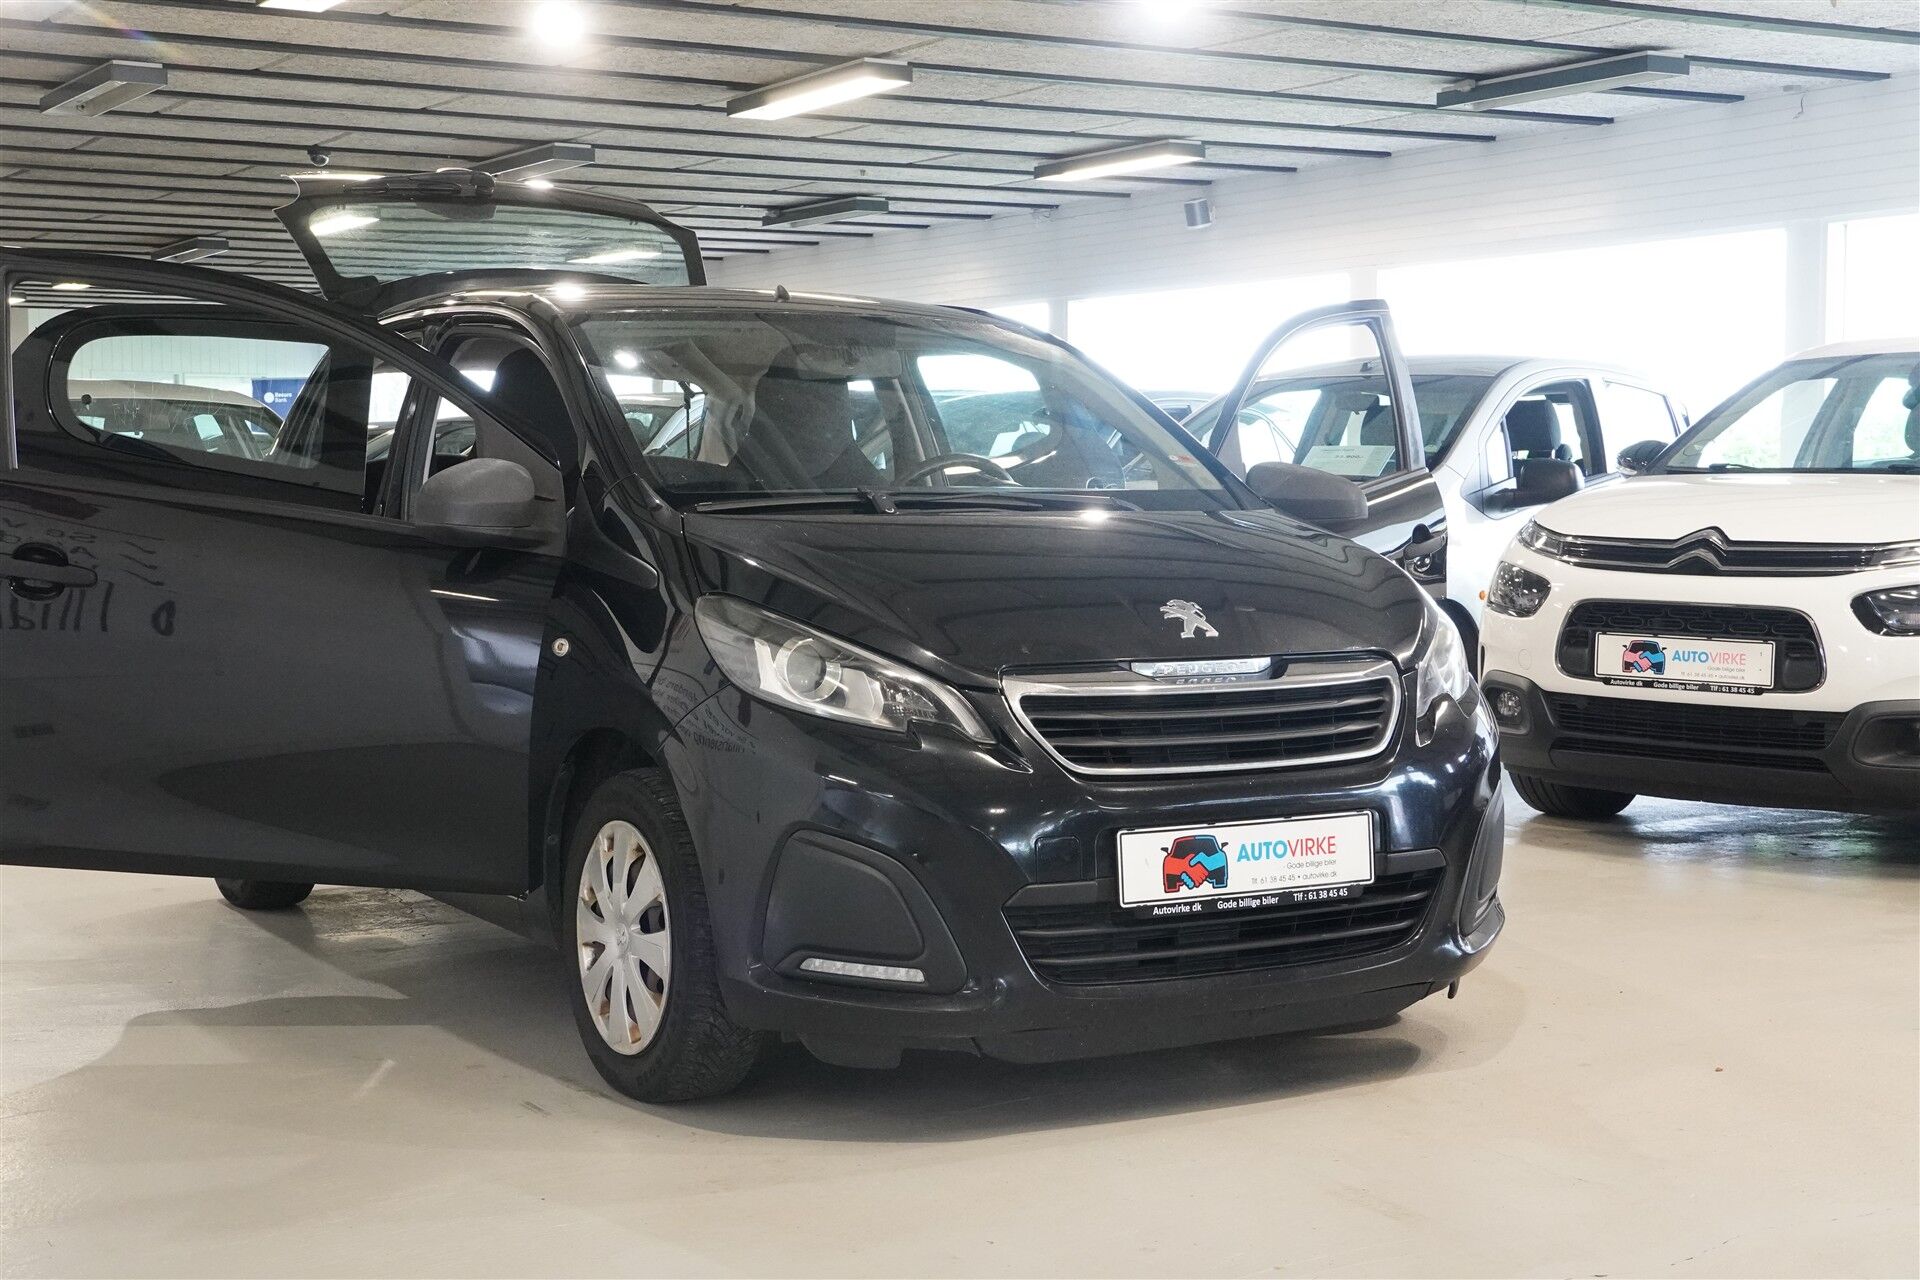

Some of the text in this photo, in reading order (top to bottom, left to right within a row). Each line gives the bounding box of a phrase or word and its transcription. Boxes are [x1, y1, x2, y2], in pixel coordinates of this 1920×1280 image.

[1671, 650, 1746, 665] AUTOVIRKE
[1653, 681, 1668, 689] Gode
[1237, 835, 1336, 862] AUTOVIRKE
[1152, 903, 1190, 915] Autovirke
[1192, 903, 1202, 911] dk
[1217, 900, 1237, 910] Gode
[1238, 897, 1260, 908] billige
[1262, 895, 1279, 905] biler
[1308, 891, 1317, 900] 61
[1319, 890, 1328, 899] 38
[1329, 889, 1338, 897] 45
[1339, 888, 1348, 896] 45
